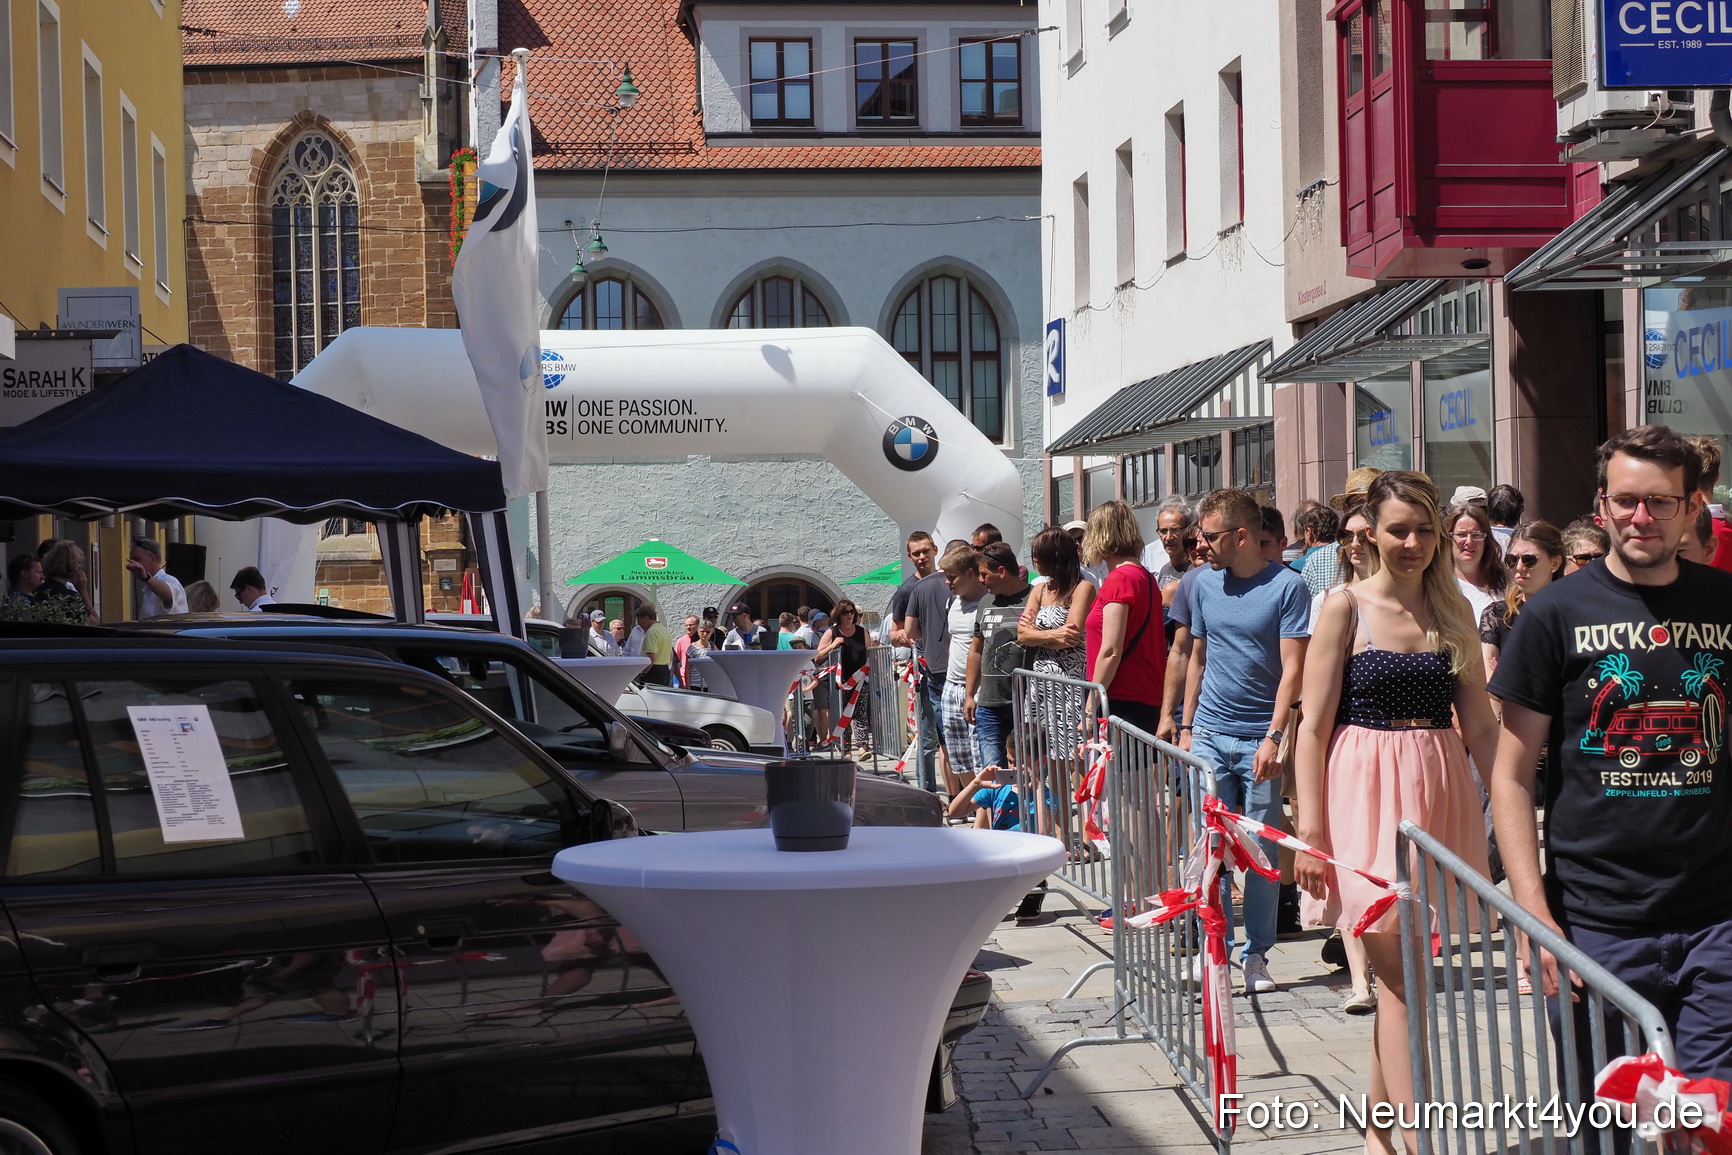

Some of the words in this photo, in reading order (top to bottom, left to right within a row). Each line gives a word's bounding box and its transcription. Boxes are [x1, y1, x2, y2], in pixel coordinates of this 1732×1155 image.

[1618, 1, 1732, 35] CECIL
[1658, 40, 1679, 49] EST.
[1681, 40, 1702, 49] 1989
[1674, 319, 1732, 379] CECIL
[554, 363, 577, 372] BMW
[3, 368, 66, 388] SARAH
[72, 367, 86, 387] K
[3, 389, 29, 398] MODE
[31, 389, 37, 398] &
[40, 389, 86, 398] LIFESTYLE
[578, 400, 614, 417] ONE
[619, 398, 698, 417] PASSION.
[1440, 387, 1476, 432] CECIL
[578, 419, 614, 435] ONE
[618, 418, 728, 435] COMMUNITY.
[888, 417, 934, 436] BMW
[1575, 621, 1647, 653] ROCK
[1671, 621, 1732, 650] PARK
[1600, 771, 1682, 787] FESTIVAL
[1686, 769, 1713, 785] 2019
[1605, 788, 1667, 798] ZEPPELINFELD
